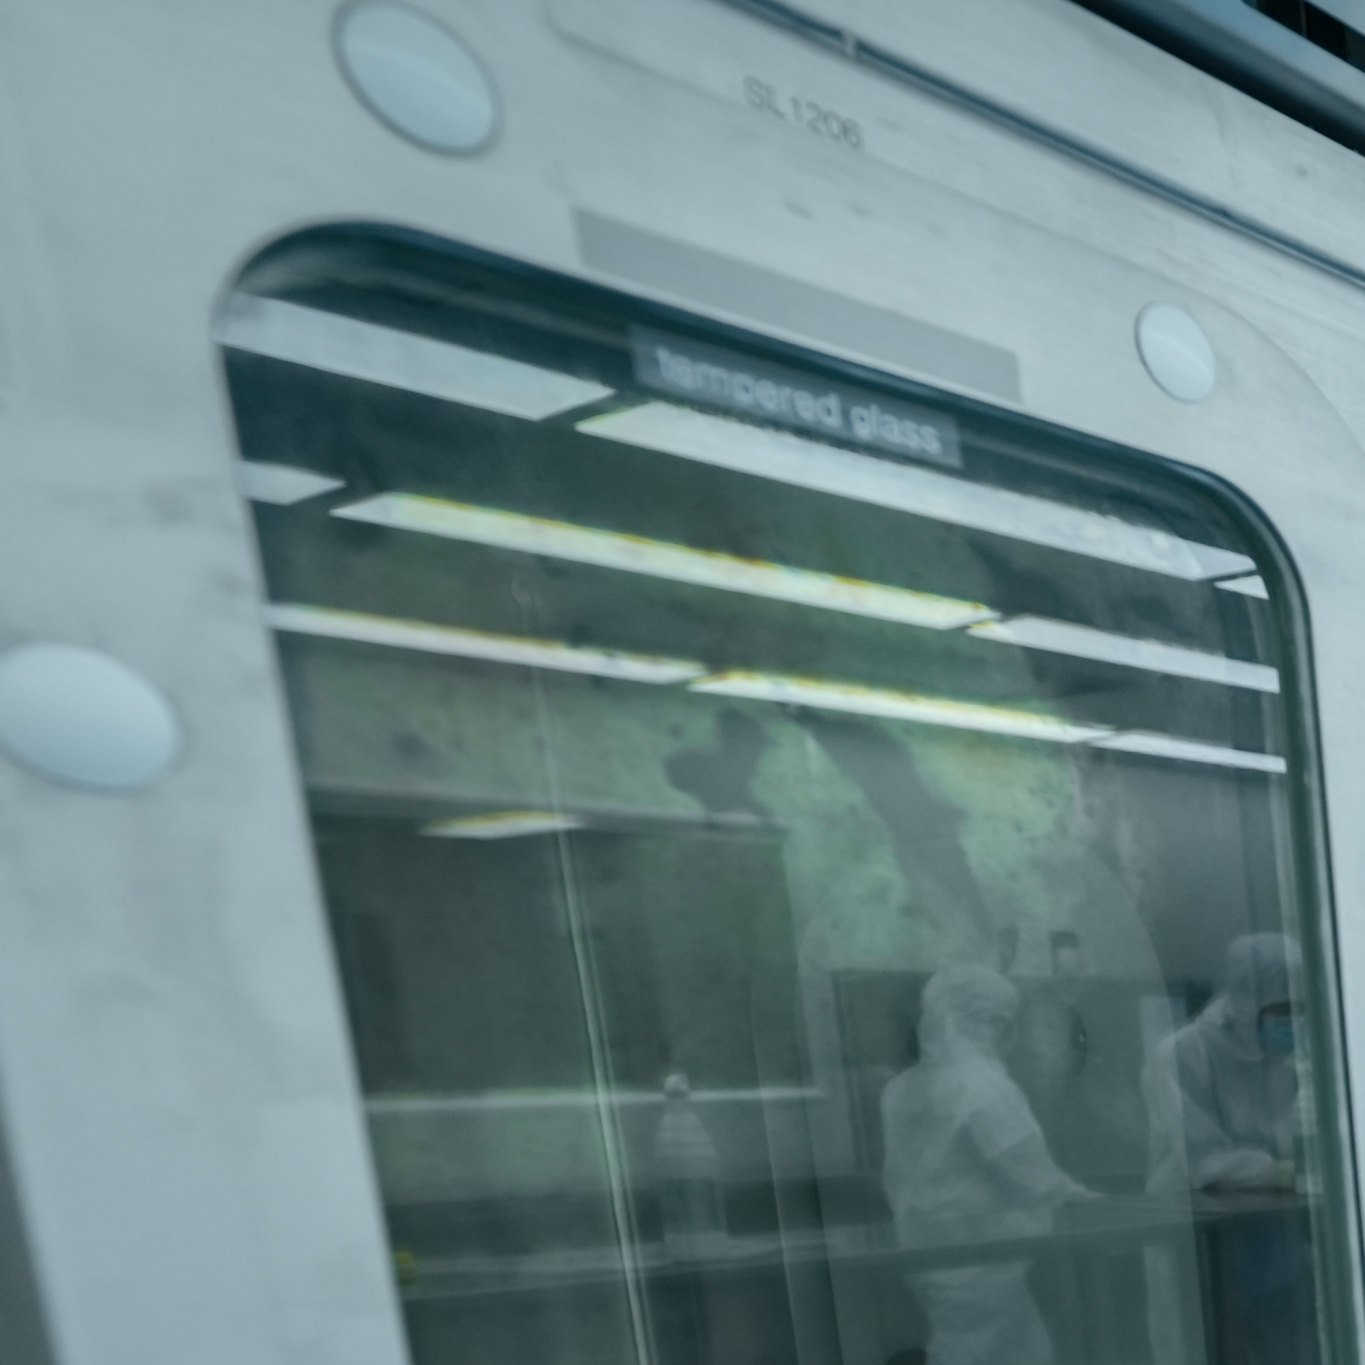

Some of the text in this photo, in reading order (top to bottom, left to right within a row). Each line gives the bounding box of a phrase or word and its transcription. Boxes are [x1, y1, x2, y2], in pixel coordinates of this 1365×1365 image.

[744, 77, 866, 150] SL1206
[656, 347, 942, 454] tempered glass
